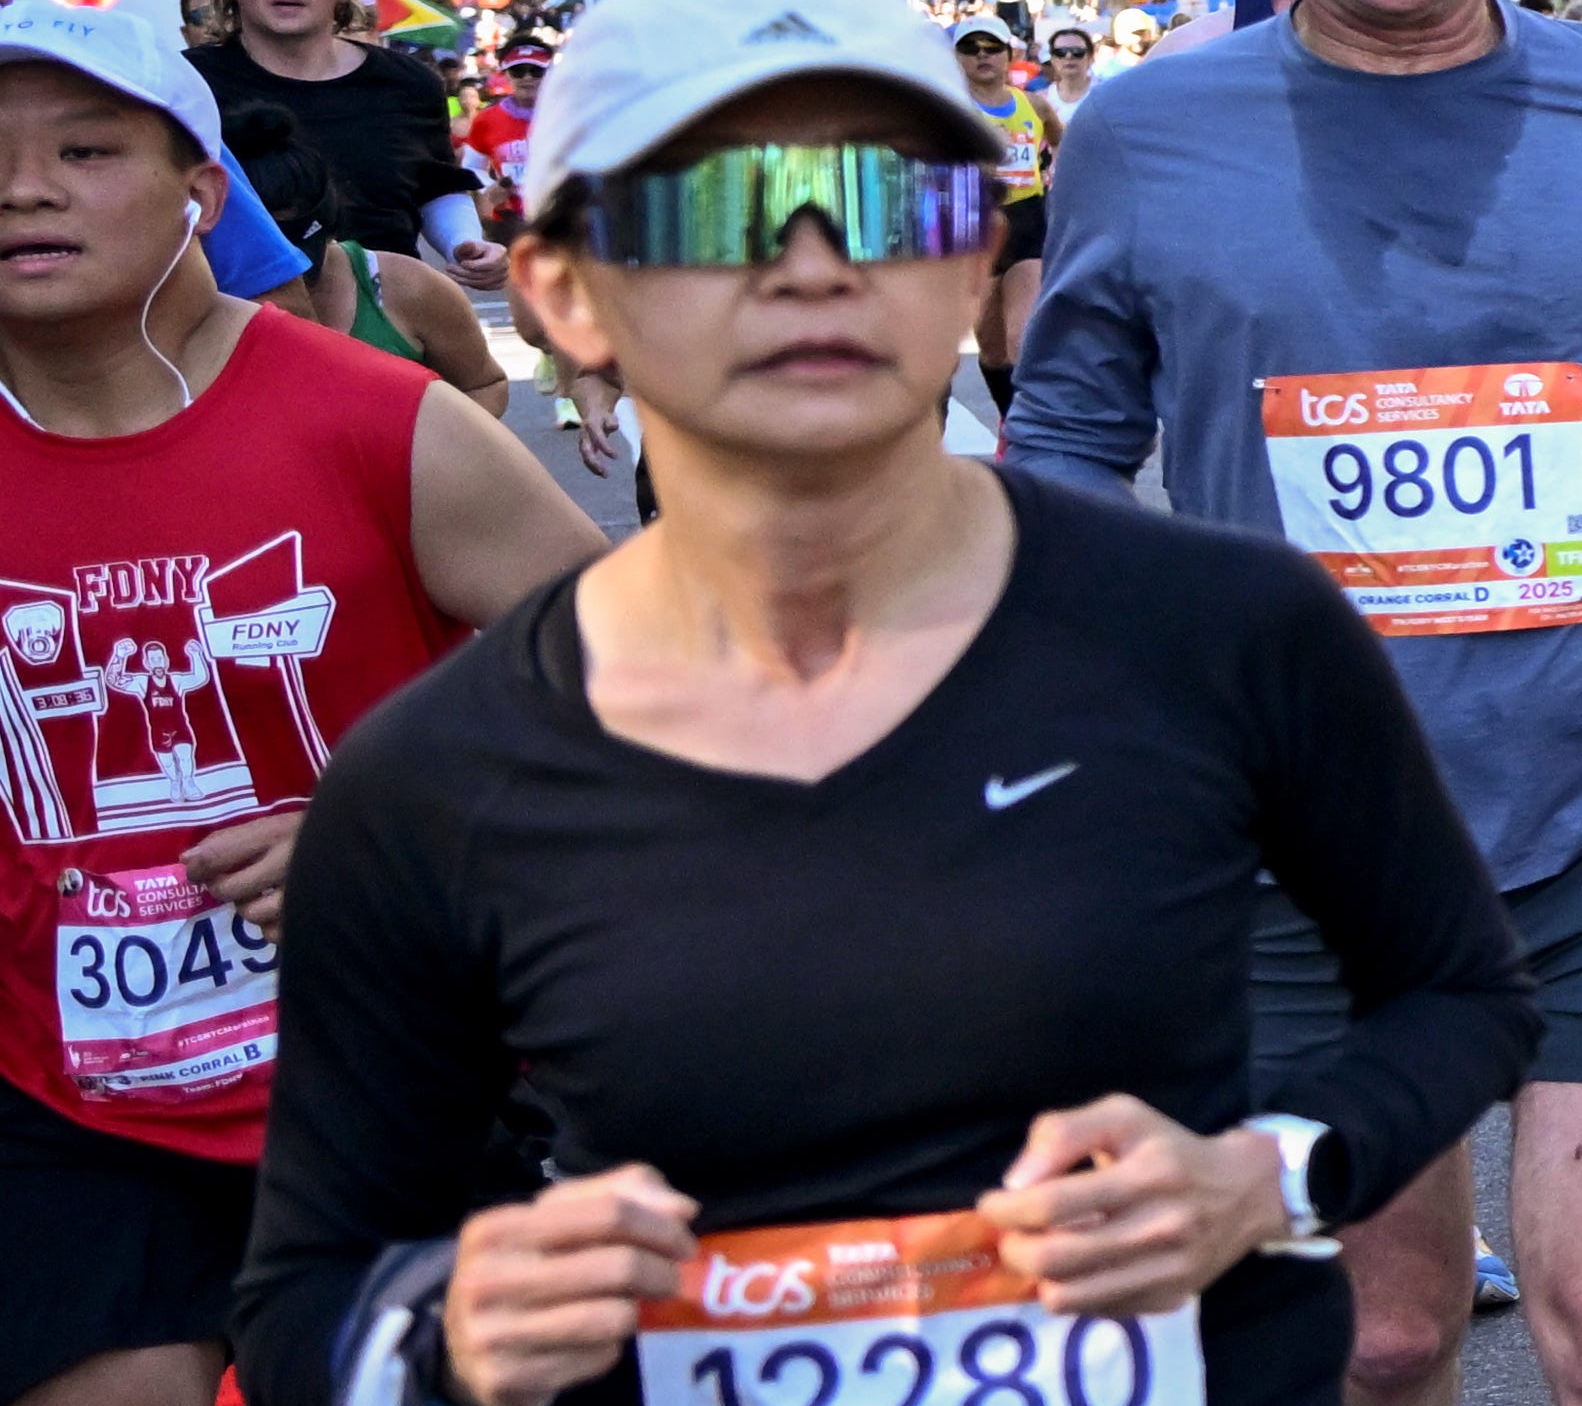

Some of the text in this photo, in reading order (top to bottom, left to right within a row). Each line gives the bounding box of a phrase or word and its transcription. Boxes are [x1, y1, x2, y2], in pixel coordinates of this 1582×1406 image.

[1375, 382, 1418, 395] TATA
[1301, 388, 1370, 427] tcs
[1376, 393, 1474, 410] CONSULTANCY
[1499, 400, 1551, 416] TATA
[1322, 433, 1537, 522] 9801
[73, 554, 210, 613] FDNY
[1519, 580, 1574, 600] 2025
[1358, 586, 1490, 606] ORANGE CORRAL D
[231, 619, 301, 641] FDNY
[134, 875, 179, 892] TATA
[136, 883, 210, 905] CONSULTA
[87, 880, 132, 919] tcs
[139, 896, 204, 917] SERVICES
[178, 1052, 243, 1079] CORRAL
[243, 1042, 263, 1062] B
[703, 1253, 818, 1316] tcs
